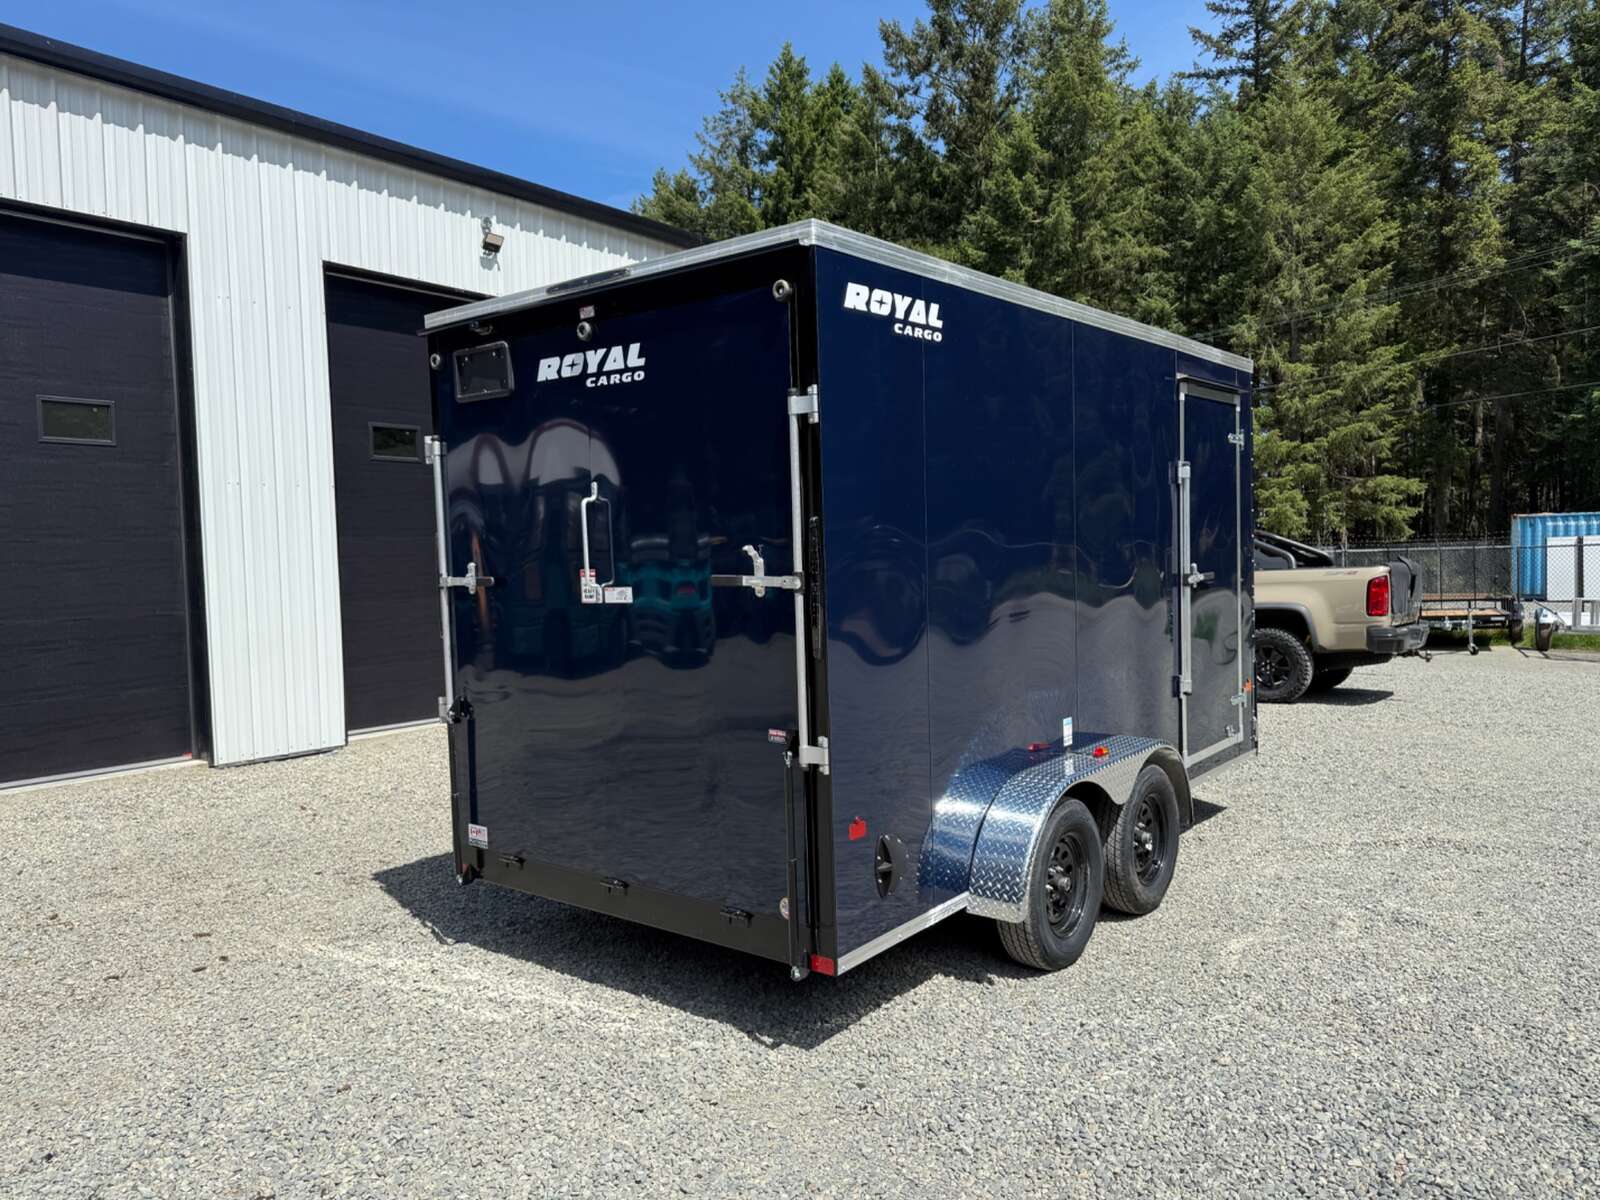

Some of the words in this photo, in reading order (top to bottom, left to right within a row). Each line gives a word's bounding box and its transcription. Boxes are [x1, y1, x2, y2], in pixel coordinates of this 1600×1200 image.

[844, 281, 943, 329] ROYAL
[893, 322, 943, 343] CARGO
[537, 342, 646, 382] ROYAL
[585, 370, 645, 388] CARGO
